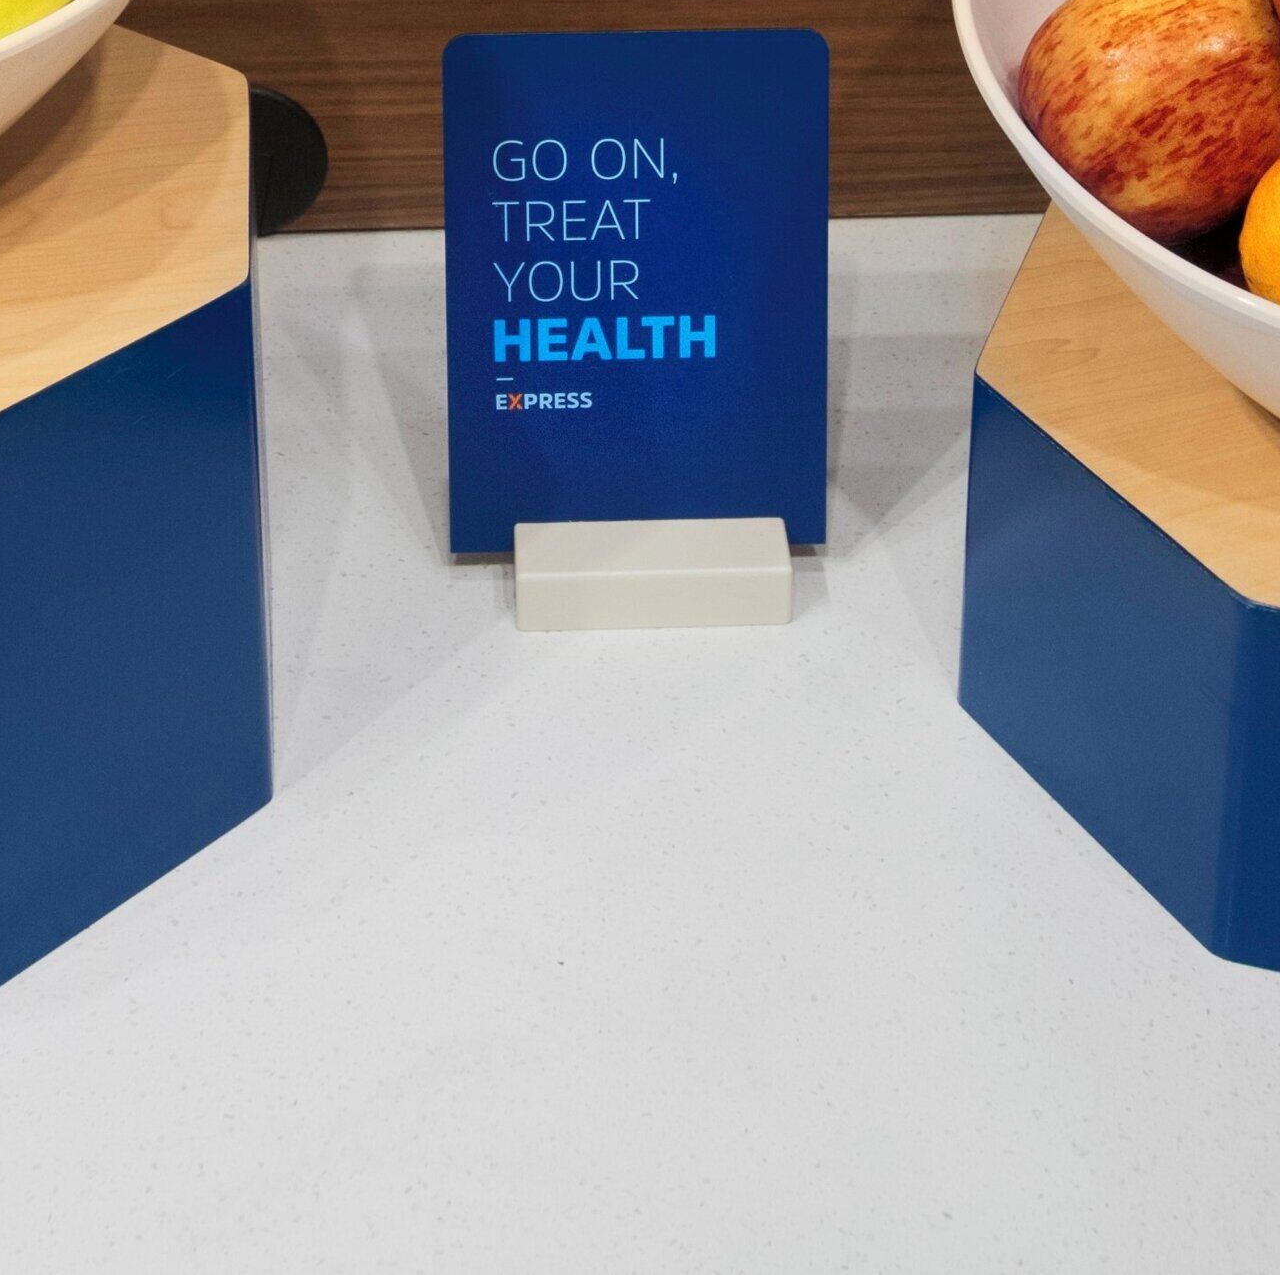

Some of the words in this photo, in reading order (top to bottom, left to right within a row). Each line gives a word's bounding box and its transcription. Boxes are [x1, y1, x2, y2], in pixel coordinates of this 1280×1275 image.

[492, 138, 568, 182] GO
[590, 137, 679, 185] ON,
[491, 199, 651, 243] TREAT
[493, 260, 640, 303] YOUR
[493, 314, 717, 363] HEALTH
[495, 391, 593, 411] EXPRESS
